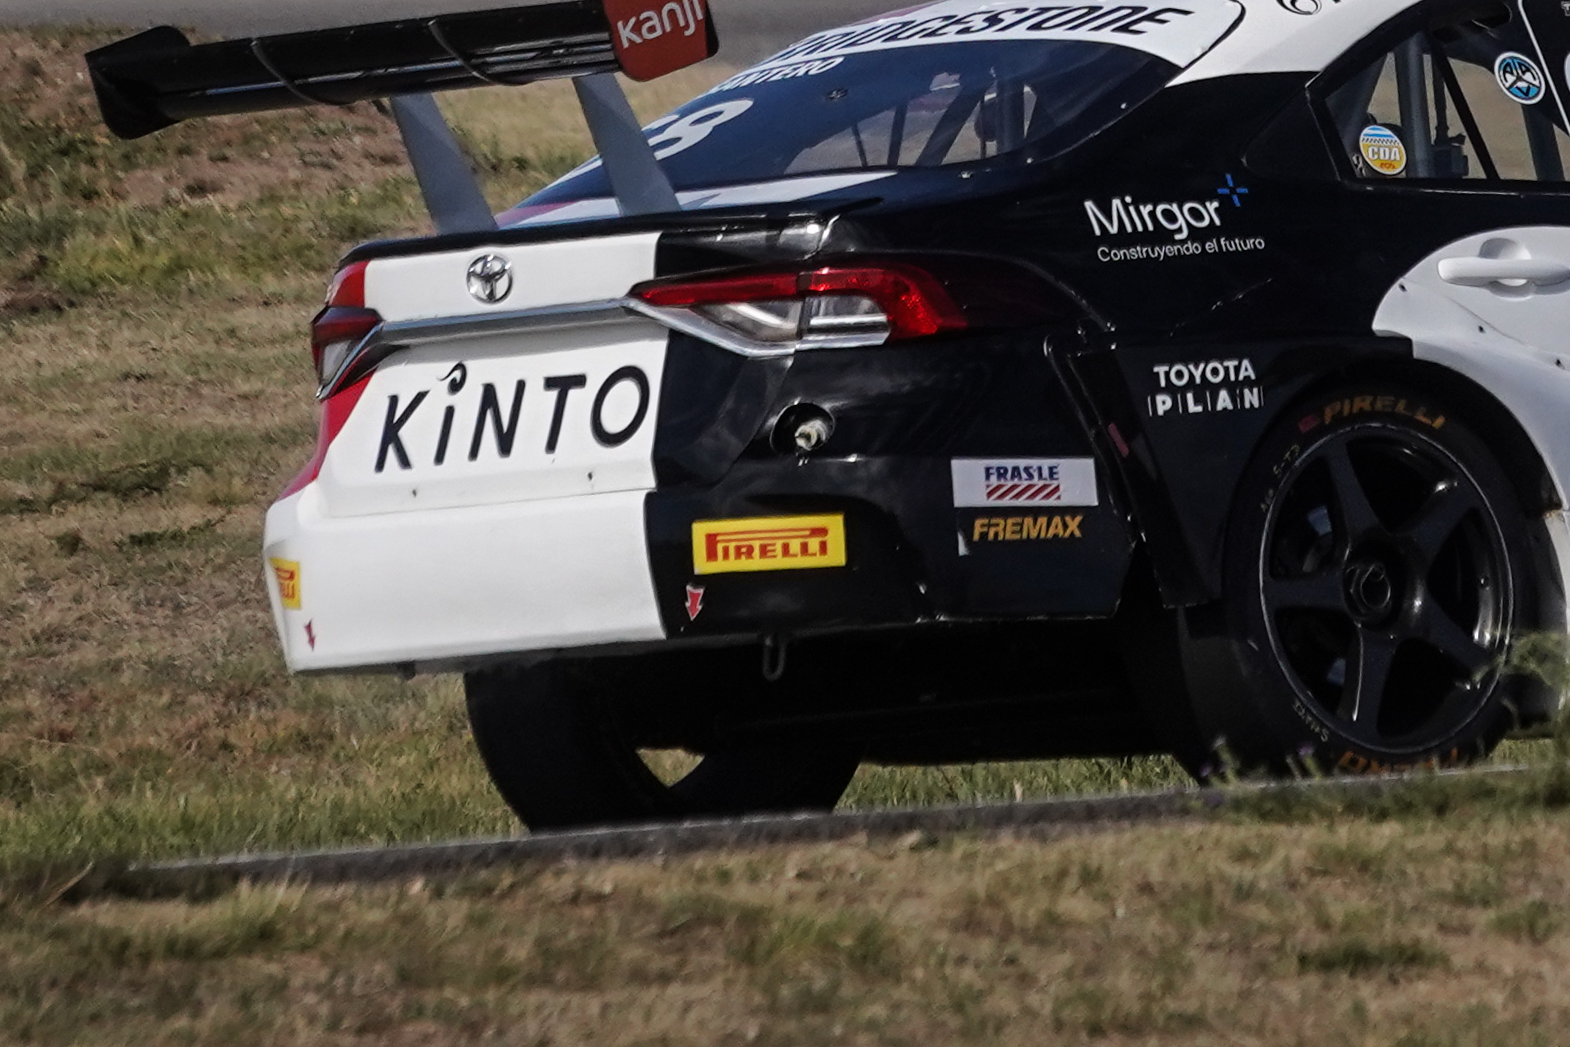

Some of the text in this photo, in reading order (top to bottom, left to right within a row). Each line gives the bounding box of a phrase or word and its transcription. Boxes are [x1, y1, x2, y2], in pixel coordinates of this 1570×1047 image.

[1368, 145, 1401, 162] CDA
[1084, 195, 1221, 241] Mirgor
[1097, 237, 1265, 262] Construyendo el futuro
[1154, 359, 1256, 387] TOYOTA
[1322, 394, 1446, 430] PIRELLI
[972, 515, 1083, 542] FREMAX
[705, 526, 829, 562] PIRELLI
